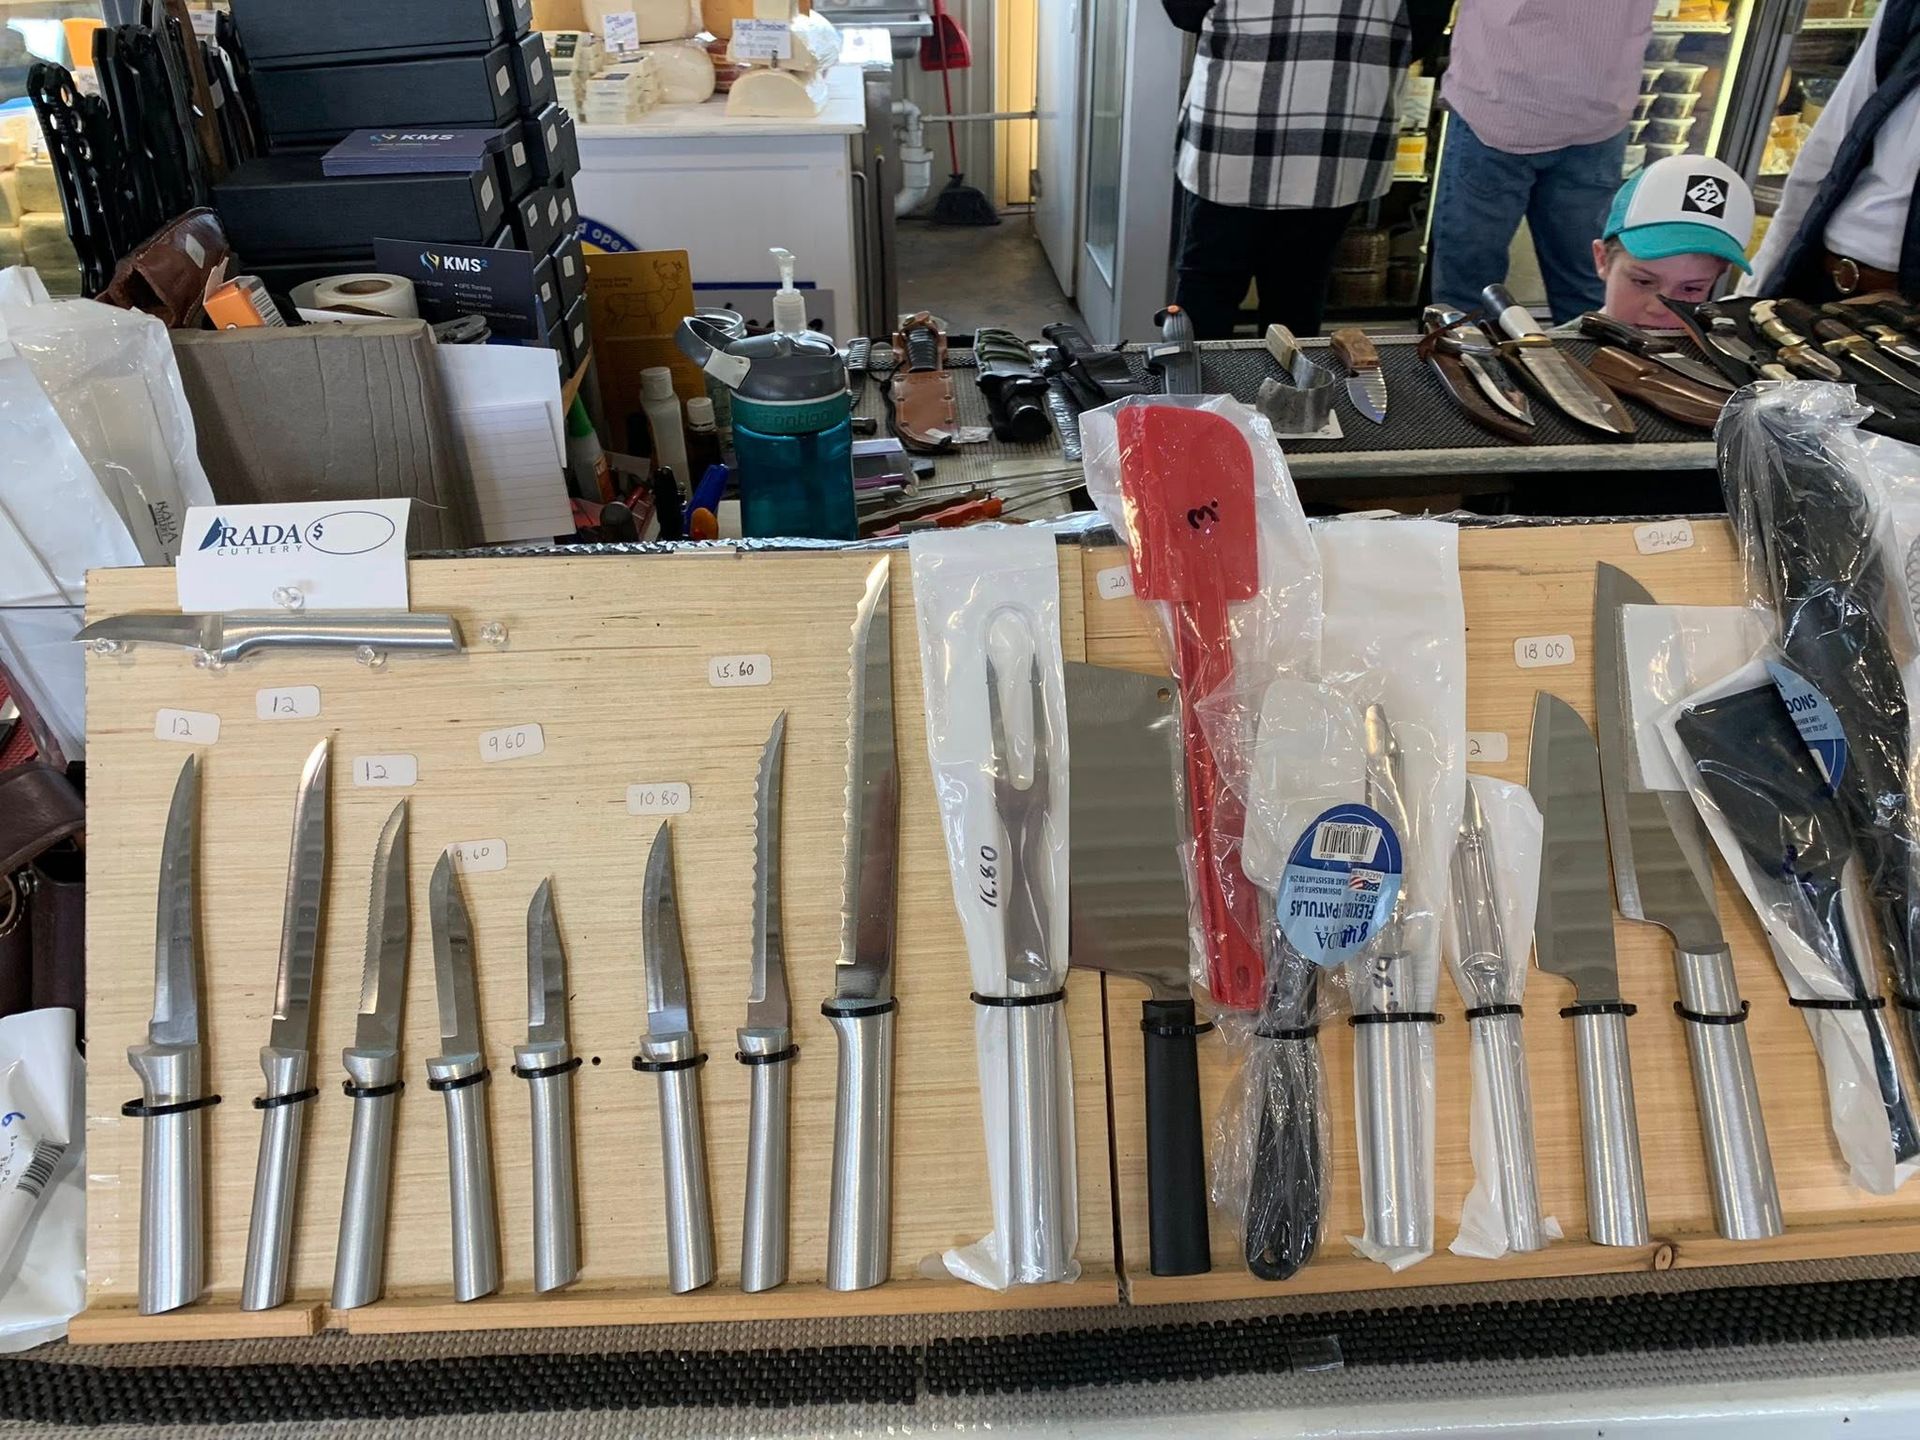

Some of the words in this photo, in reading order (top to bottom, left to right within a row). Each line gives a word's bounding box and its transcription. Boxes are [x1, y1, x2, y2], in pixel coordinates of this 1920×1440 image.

[1695, 187, 1719, 204] 22
[218, 523, 303, 547] RADA
[217, 545, 303, 557] CUTLERY
[716, 661, 755, 679] 15.60
[272, 696, 298, 714] 12
[172, 717, 193, 736] 12
[365, 761, 389, 781] 12
[979, 845, 998, 908] 16.80
